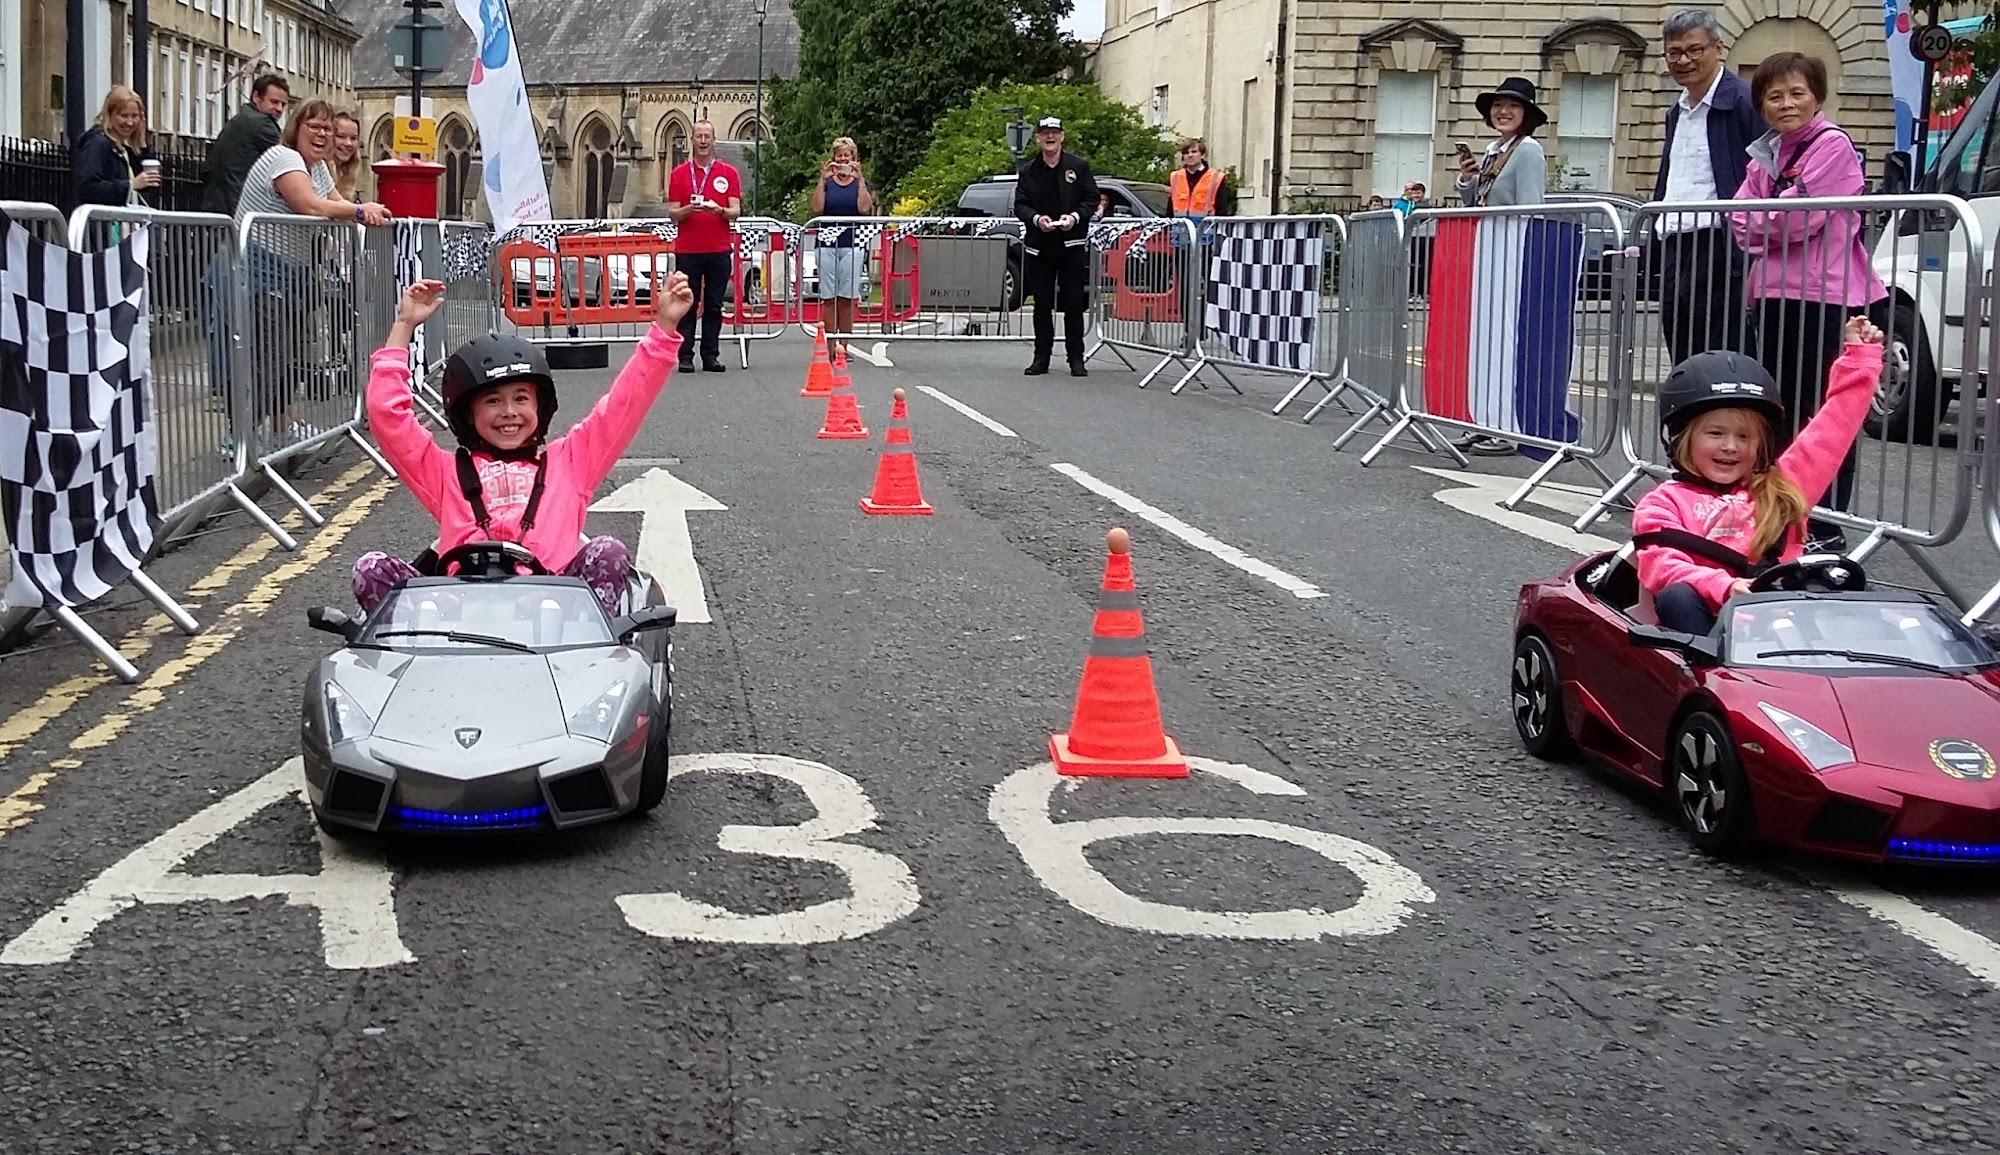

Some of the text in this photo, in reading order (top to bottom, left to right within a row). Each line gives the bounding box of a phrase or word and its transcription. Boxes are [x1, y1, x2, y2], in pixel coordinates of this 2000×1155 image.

[1924, 36, 1948, 51] 20
[404, 134, 424, 143] Parking
[930, 289, 971, 298] RENTED
